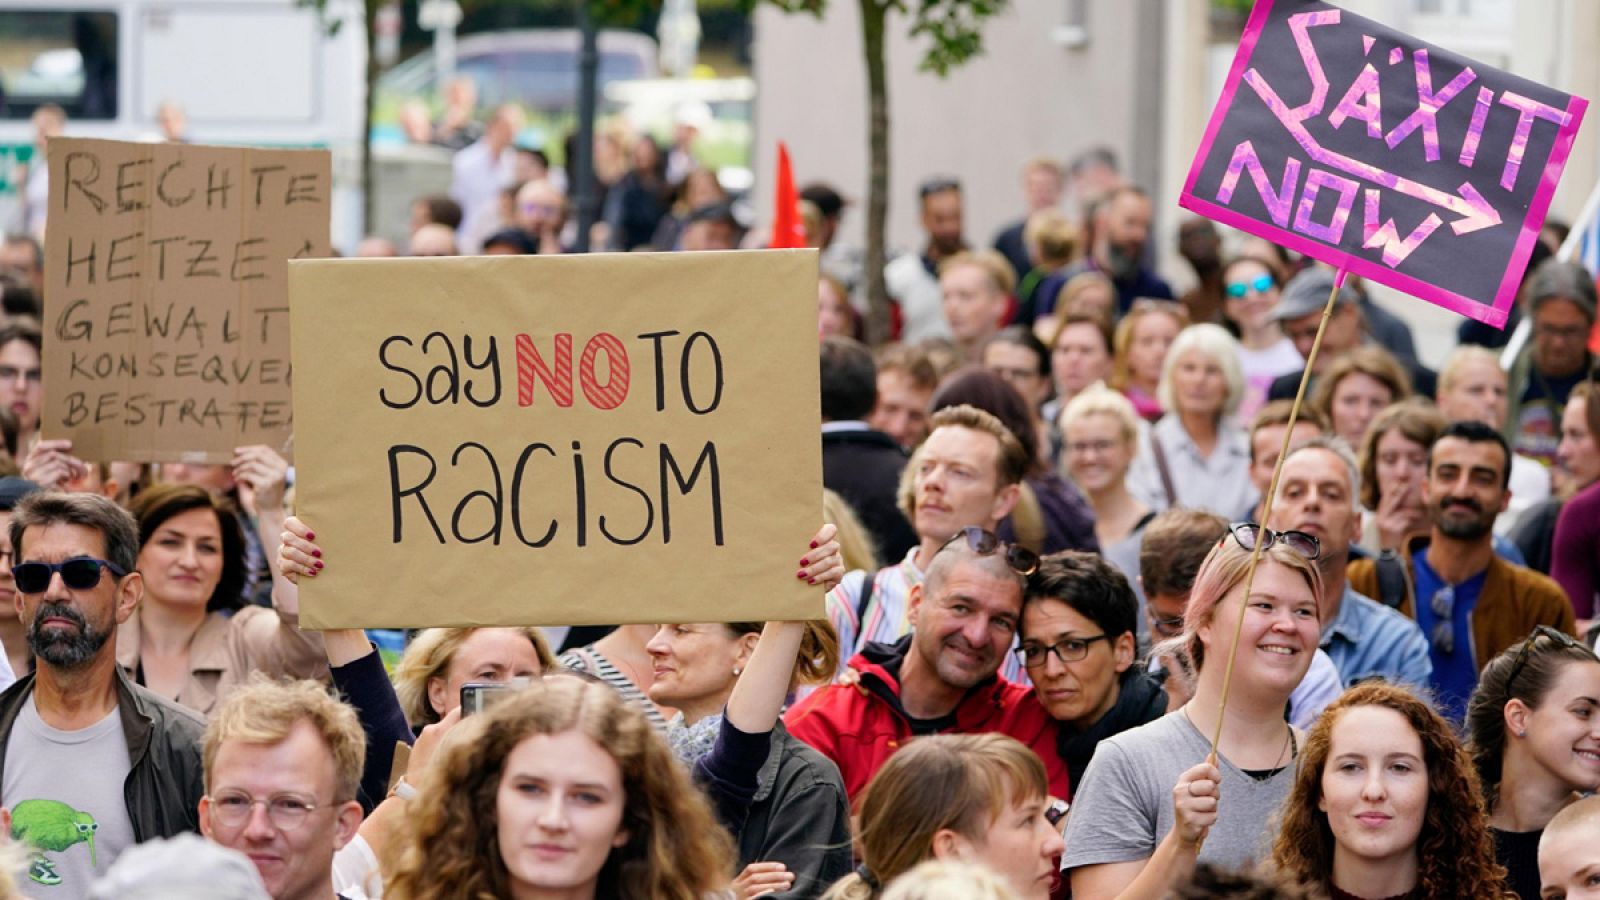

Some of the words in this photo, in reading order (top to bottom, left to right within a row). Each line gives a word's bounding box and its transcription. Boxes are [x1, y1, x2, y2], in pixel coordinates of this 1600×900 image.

[1243, 8, 1573, 192] SÄXIT
[63, 152, 322, 214] RECHTE
[1215, 139, 1443, 269] NOW
[65, 232, 269, 287] HETZE
[56, 299, 290, 348] GEWALT
[514, 332, 631, 411] NO
[637, 330, 724, 415] TO
